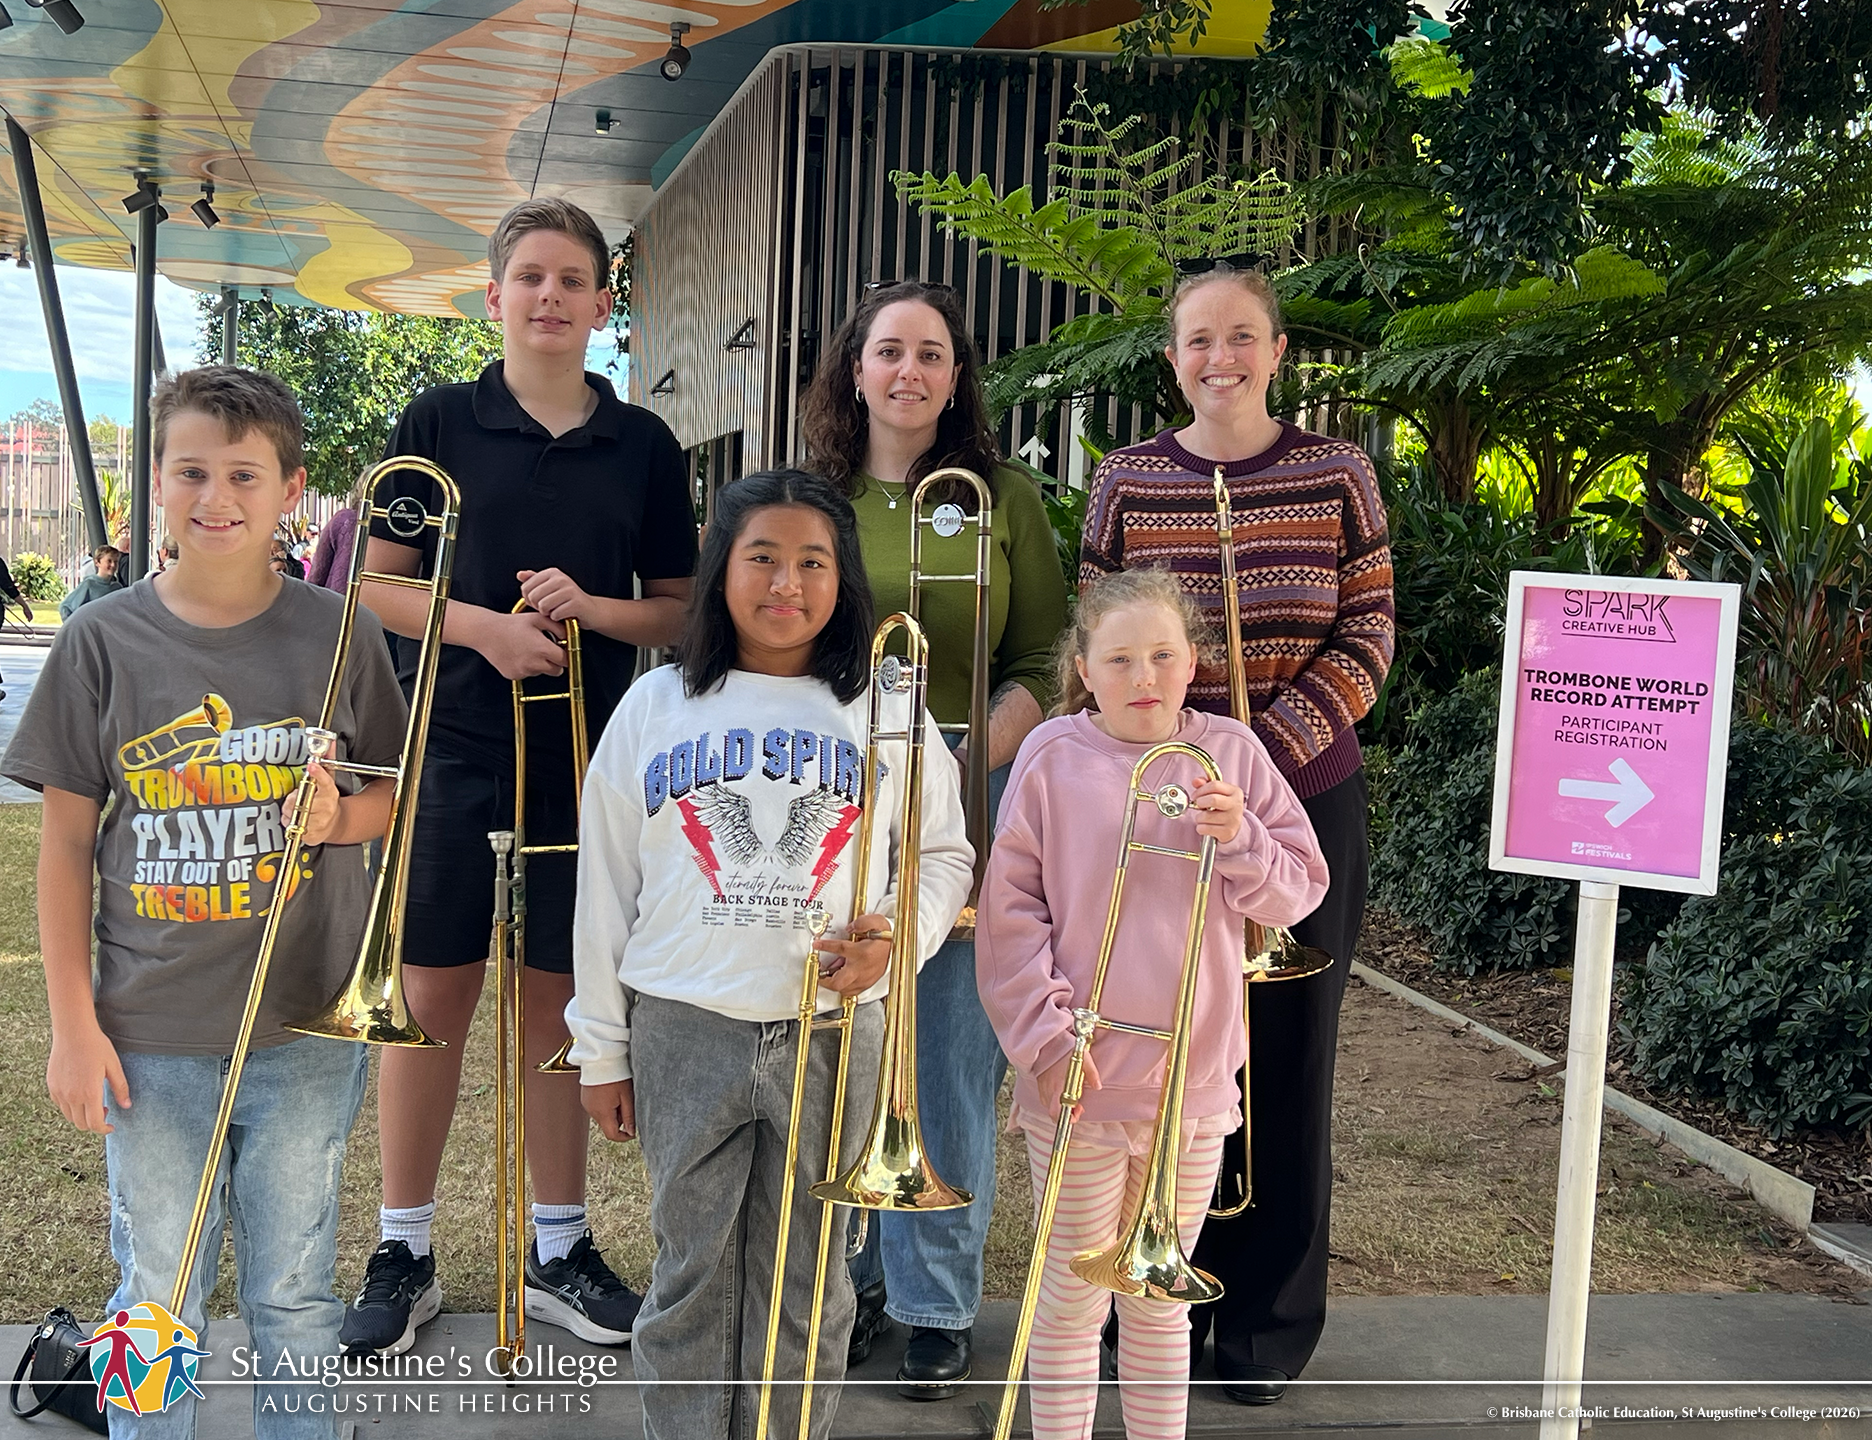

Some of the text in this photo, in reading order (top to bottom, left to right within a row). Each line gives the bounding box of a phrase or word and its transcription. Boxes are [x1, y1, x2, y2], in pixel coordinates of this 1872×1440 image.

[1563, 588, 1673, 631] SPARK
[1561, 620, 1656, 636] CREATIVE HUB
[1524, 669, 1709, 697] TROMBONE WORLD
[1531, 688, 1700, 715] RECORD ATTEMPT
[1561, 715, 1664, 736] PARTICIPANT
[220, 726, 308, 766] GOOD
[1554, 730, 1668, 752] REGISTRATION
[644, 728, 755, 818] BOLD
[1585, 848, 1632, 861] FESTIVALS
[135, 858, 252, 885] STAY OUT OF
[725, 871, 809, 898] eternity forever
[130, 883, 252, 923] TREBLE
[713, 894, 823, 910] BACK STAGE TOUR
